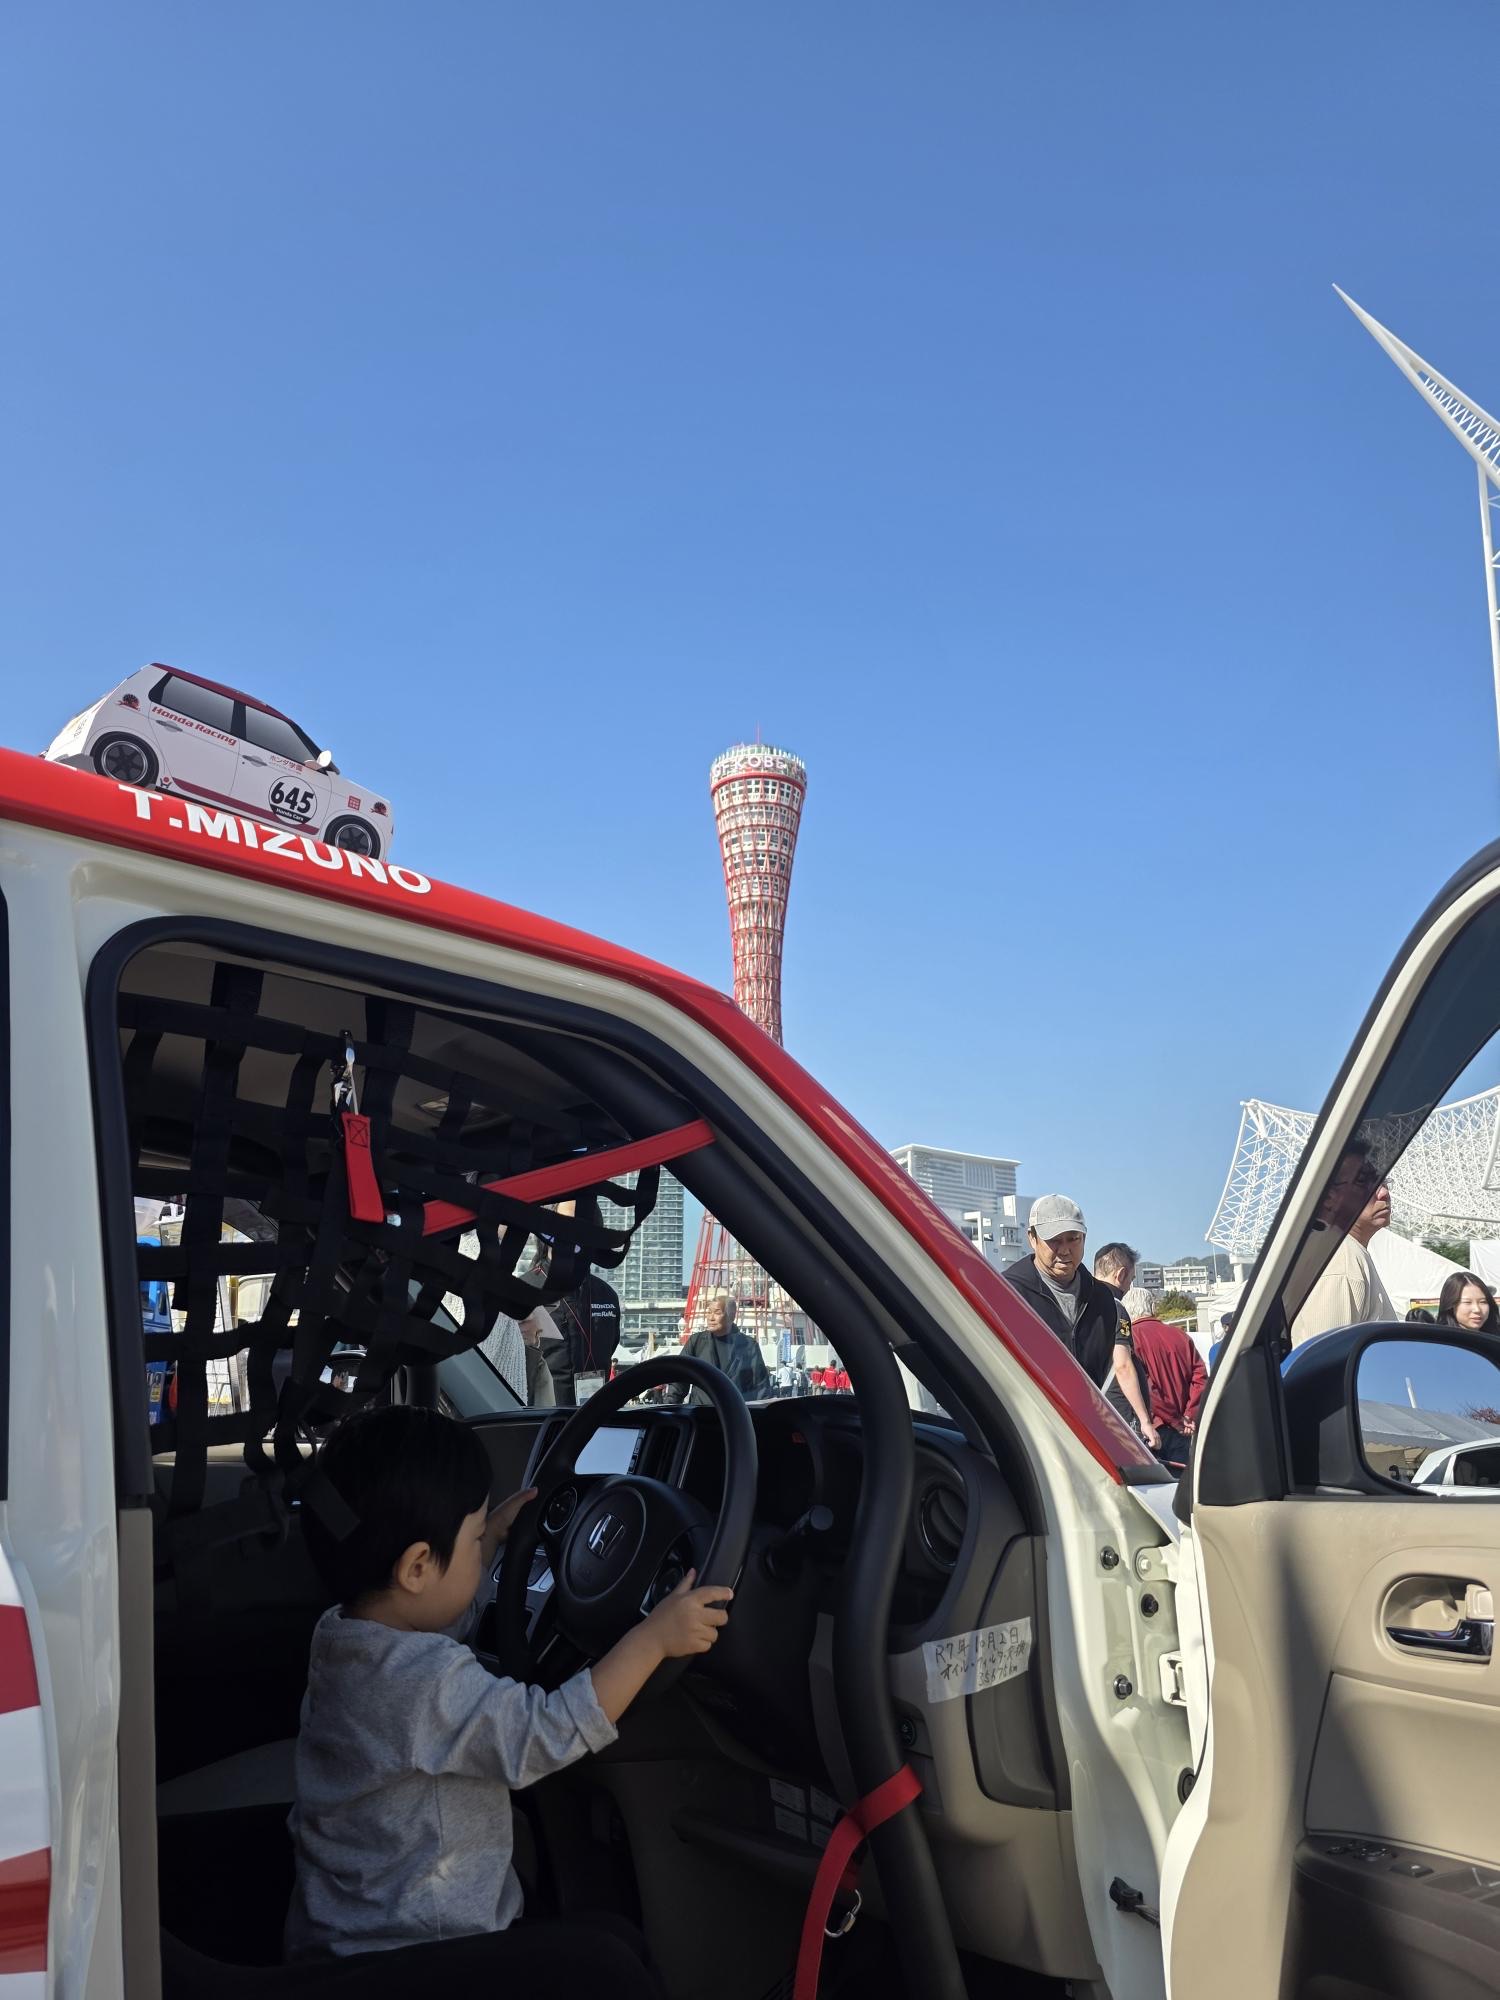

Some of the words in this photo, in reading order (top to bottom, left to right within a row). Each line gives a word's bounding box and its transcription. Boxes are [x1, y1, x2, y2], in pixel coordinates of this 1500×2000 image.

[152, 706, 194, 728] Honda
[195, 723, 238, 746] Racing
[734, 755, 785, 770] KOBE
[270, 781, 315, 814] 645
[118, 784, 432, 894] T.MIZUNO
